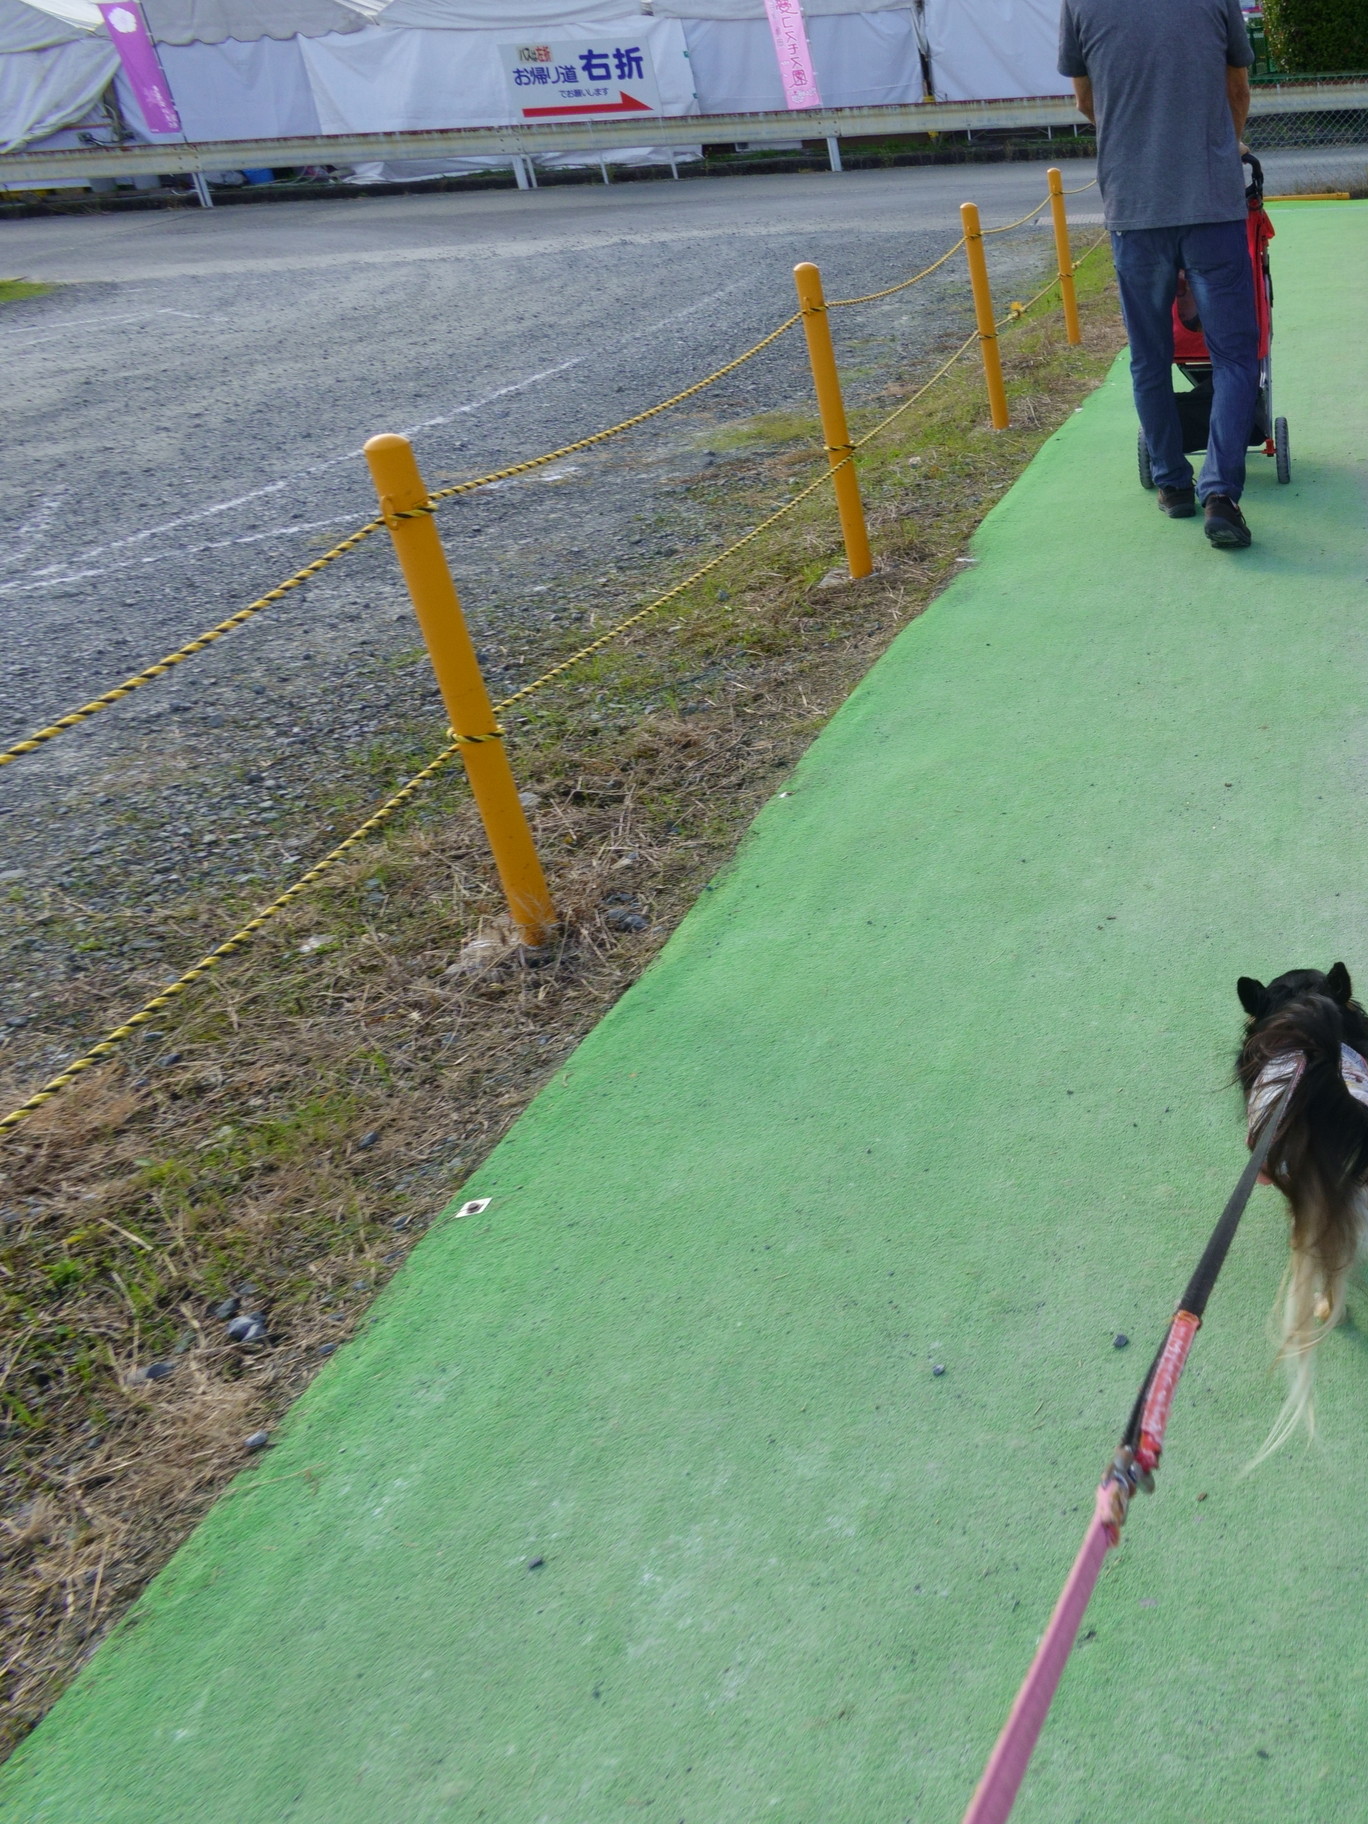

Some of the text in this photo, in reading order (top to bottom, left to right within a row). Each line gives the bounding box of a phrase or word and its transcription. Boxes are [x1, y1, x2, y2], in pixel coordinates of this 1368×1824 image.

[513, 47, 644, 86] お帰り道 右折
[559, 88, 609, 99] でお願いします
